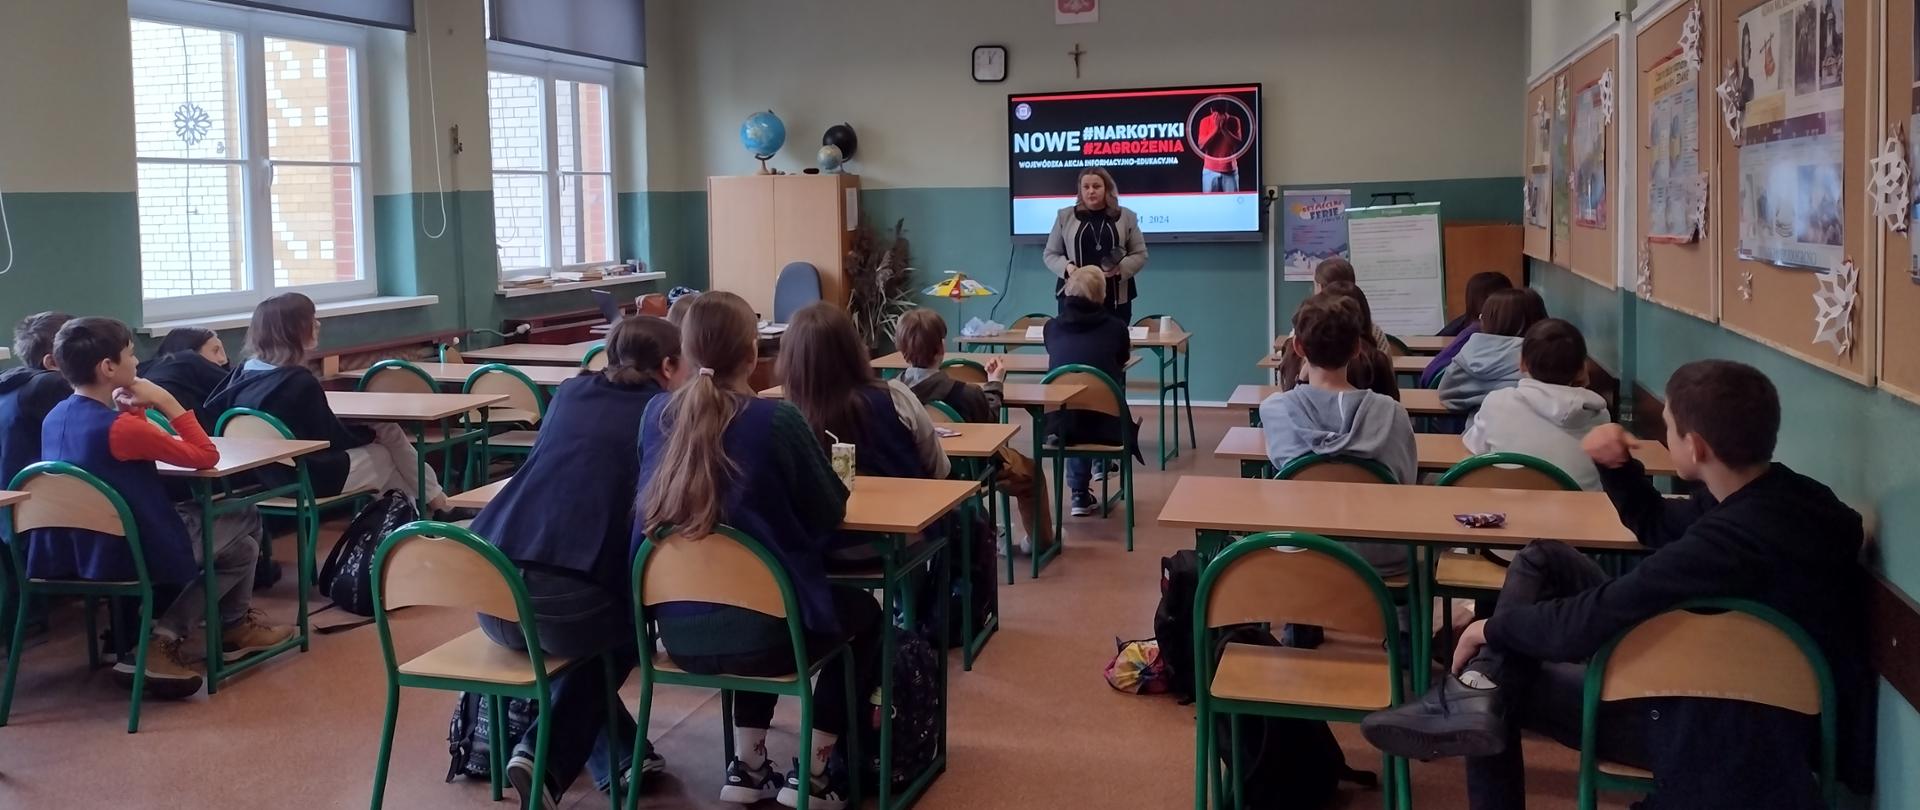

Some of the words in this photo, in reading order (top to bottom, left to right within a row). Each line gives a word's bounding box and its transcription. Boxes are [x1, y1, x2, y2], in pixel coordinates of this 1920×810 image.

[1083, 122, 1184, 141] #NARKOTYKI
[1013, 131, 1081, 153] NOWE
[1083, 138, 1184, 155] #ZAGROŻENIA
[1064, 159, 1084, 168] AKCJA
[1149, 215, 1170, 224] 2024
